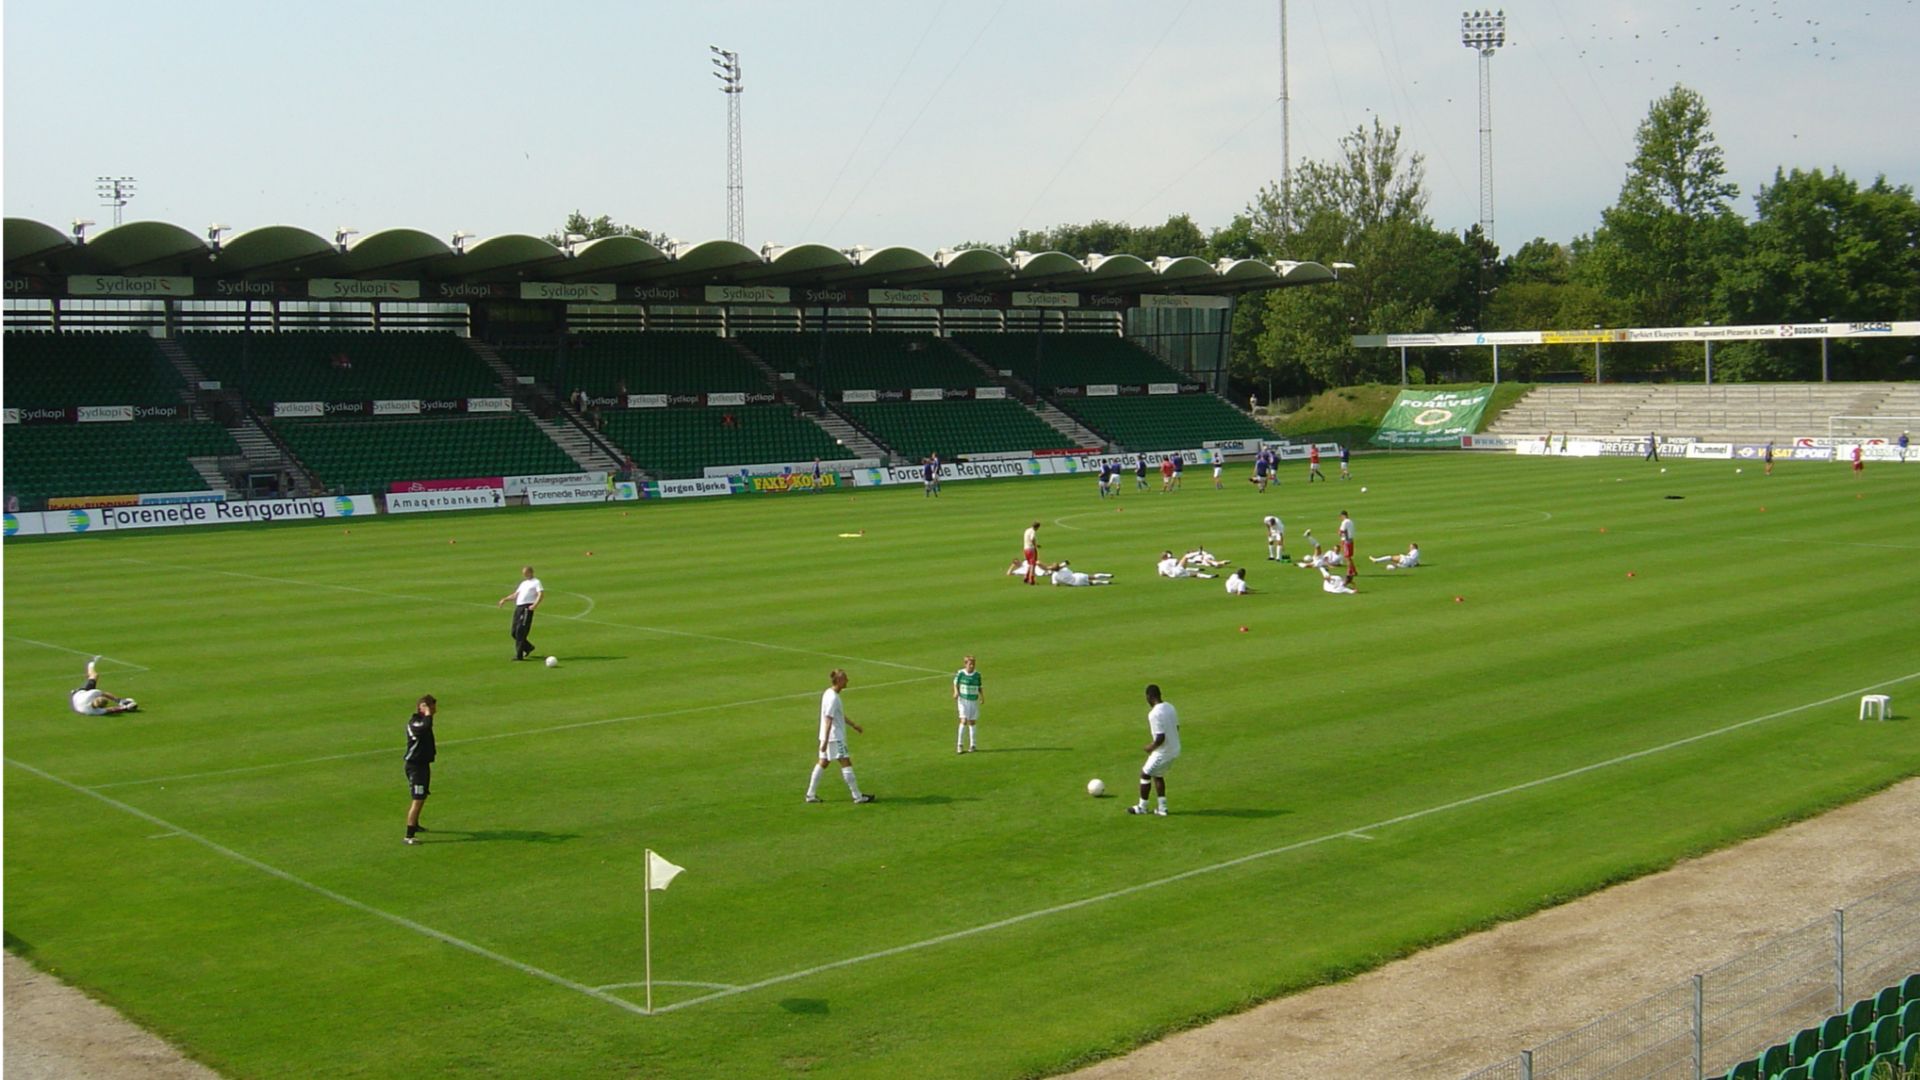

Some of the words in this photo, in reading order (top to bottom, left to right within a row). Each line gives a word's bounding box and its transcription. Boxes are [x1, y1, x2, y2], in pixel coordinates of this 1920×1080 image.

[96, 278, 156, 296] Sydkopi
[217, 279, 274, 295] Sydkopi
[333, 281, 389, 296] Sydkopi
[441, 283, 491, 299] Sydkopi
[541, 285, 591, 300] Sydkopi
[634, 286, 680, 301] Sydkopi
[723, 287, 767, 301] Sydkopi
[806, 288, 846, 302] Sydkopi
[883, 290, 922, 303] Sydkopi
[956, 292, 992, 305] Sydkopi
[135, 406, 177, 419] Sydkopi
[274, 403, 314, 415] Sydkopi
[325, 402, 363, 415] Sydkopi
[422, 401, 457, 412] Sydkopi
[21, 408, 65, 421] Sydkopi
[79, 407, 122, 420] Sydkopi
[1601, 443, 1636, 453] DREYER
[1637, 444, 1646, 453] &
[1656, 443, 1687, 454] VETNY
[1758, 447, 1793, 458] VASAT
[1795, 447, 1832, 459] SPORT
[888, 464, 952, 481] Forede
[956, 461, 1024, 478] Rengøring
[754, 477, 788, 490] FAXE
[792, 473, 836, 488] KODI
[532, 488, 573, 500] Forenede
[663, 484, 694, 495] Jørgen
[696, 482, 727, 494] Bjørke
[393, 495, 487, 509] Amagerbanken
[102, 503, 206, 527] Forenede
[216, 498, 325, 522] Rengøring
